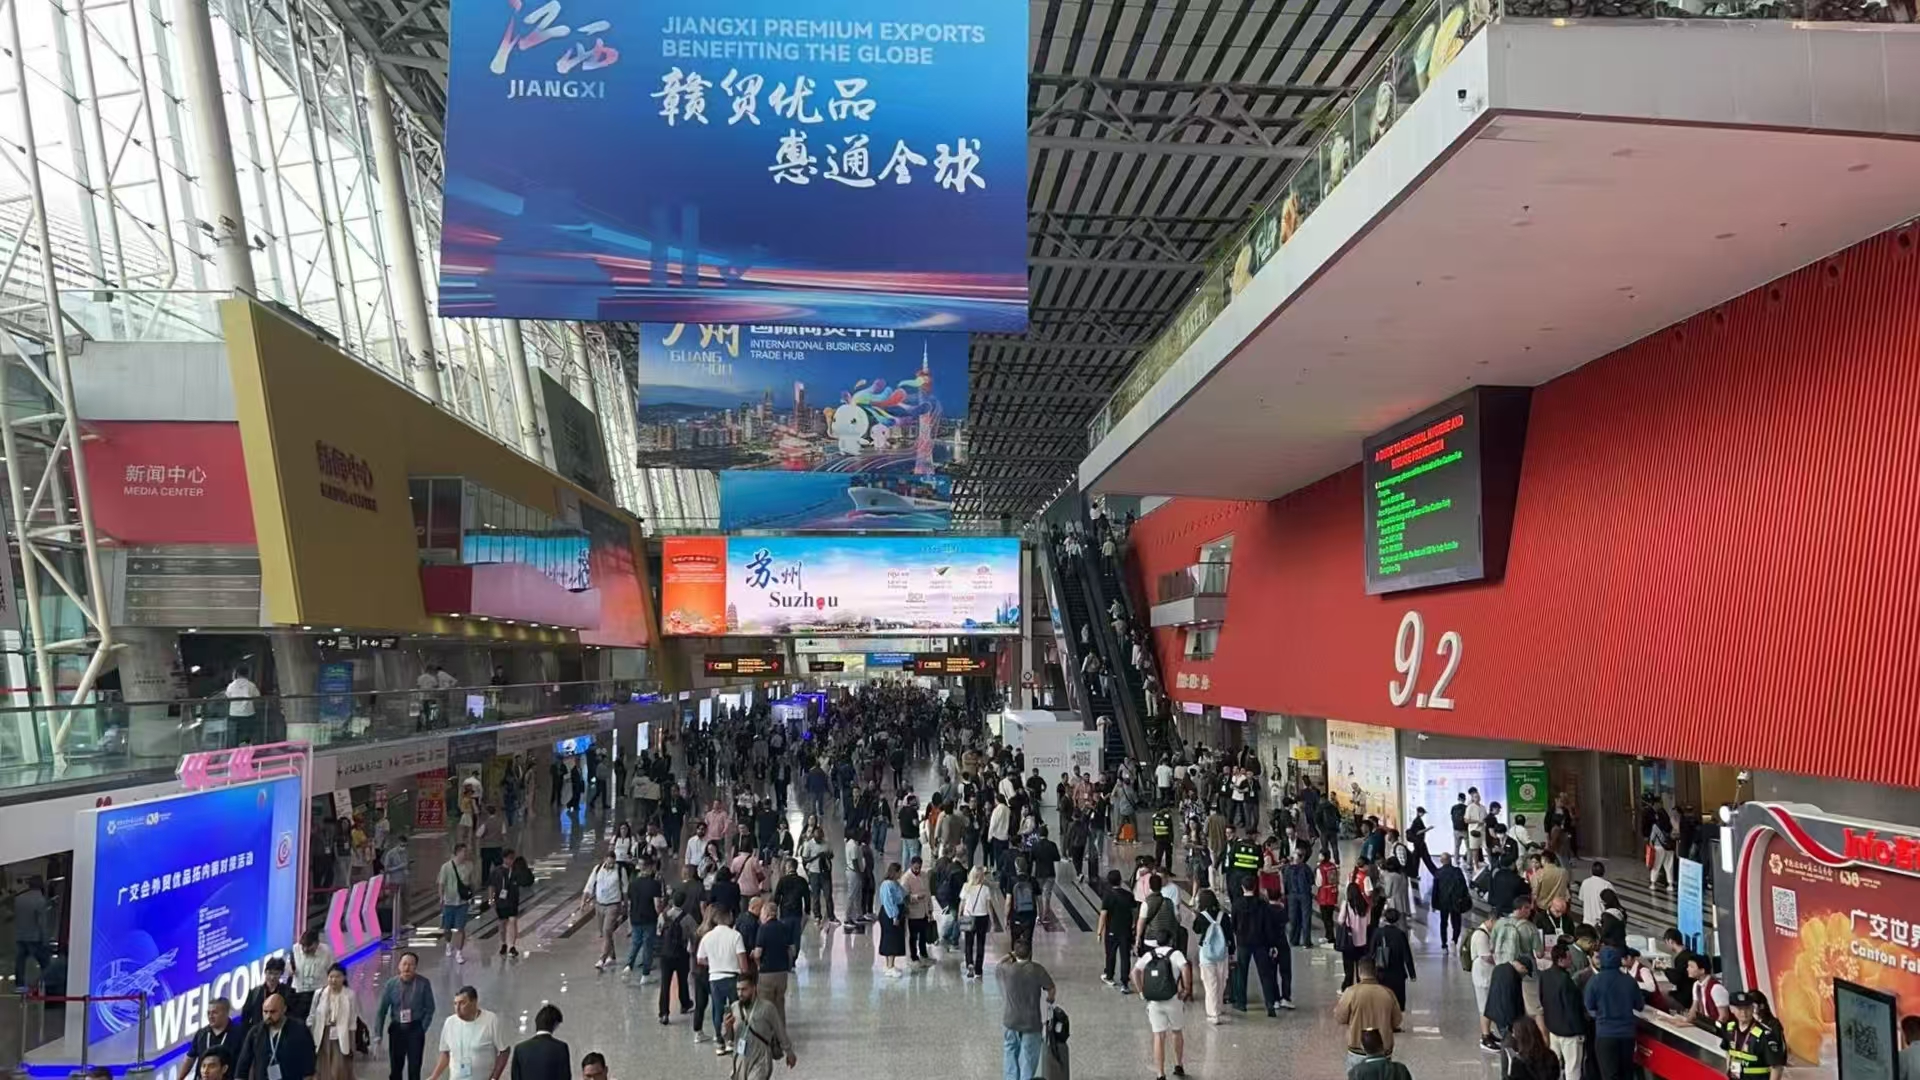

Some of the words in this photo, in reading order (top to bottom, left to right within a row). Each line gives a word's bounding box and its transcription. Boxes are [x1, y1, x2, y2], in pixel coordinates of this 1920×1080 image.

[662, 15, 757, 36] JIANGXI
[764, 18, 873, 40] PREMIUM
[879, 22, 986, 44] EXPORTS
[662, 39, 800, 61] BENEFITING
[805, 44, 851, 63] THE
[857, 45, 934, 65] GLOBE
[507, 79, 606, 99] JIANGXI
[650, 66, 877, 126] 赣贸优品
[768, 128, 986, 193] 惠通全球
[750, 339, 825, 351] INTERNATIONAL
[826, 342, 872, 352] BUSINESS
[873, 343, 895, 353] AND
[751, 350, 781, 361] TRADE
[783, 352, 805, 361] HUB
[125, 464, 207, 485] 新闻中心
[123, 485, 158, 497] MEDIA
[159, 487, 204, 497] CENTER
[745, 549, 803, 590] 苏州
[1389, 609, 1463, 710] 9.2
[1851, 939, 1897, 968] Canton
[154, 948, 286, 1050] WELCOM
